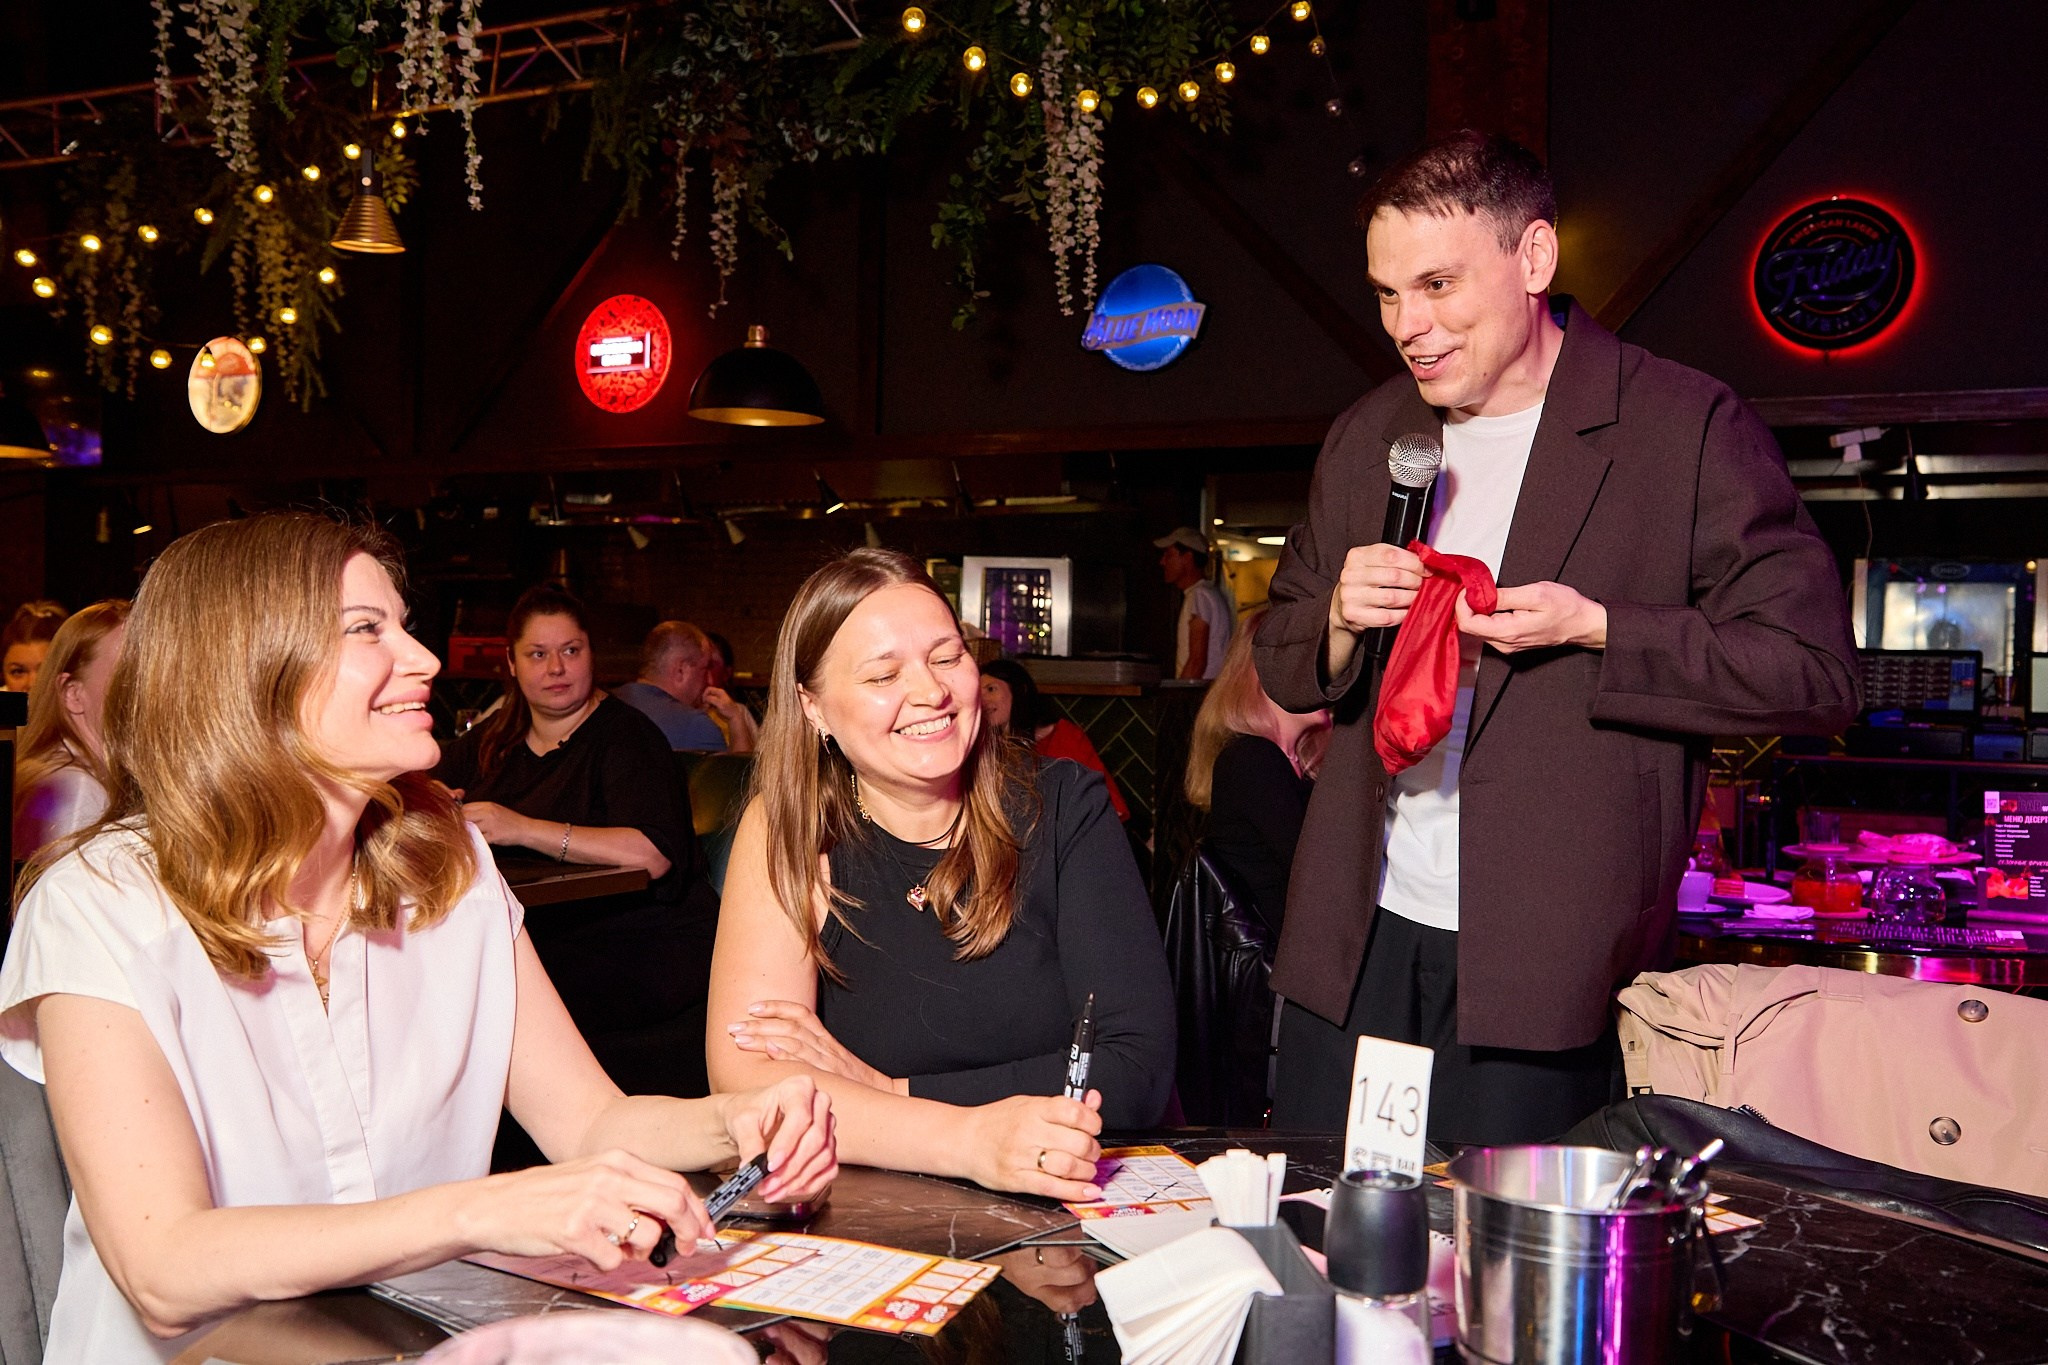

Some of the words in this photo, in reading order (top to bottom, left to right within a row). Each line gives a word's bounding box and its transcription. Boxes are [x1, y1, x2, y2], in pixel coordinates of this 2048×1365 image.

[1082, 313, 1142, 350] BLUE
[1140, 307, 1200, 337] MOON
[1358, 1076, 1422, 1138] 143
